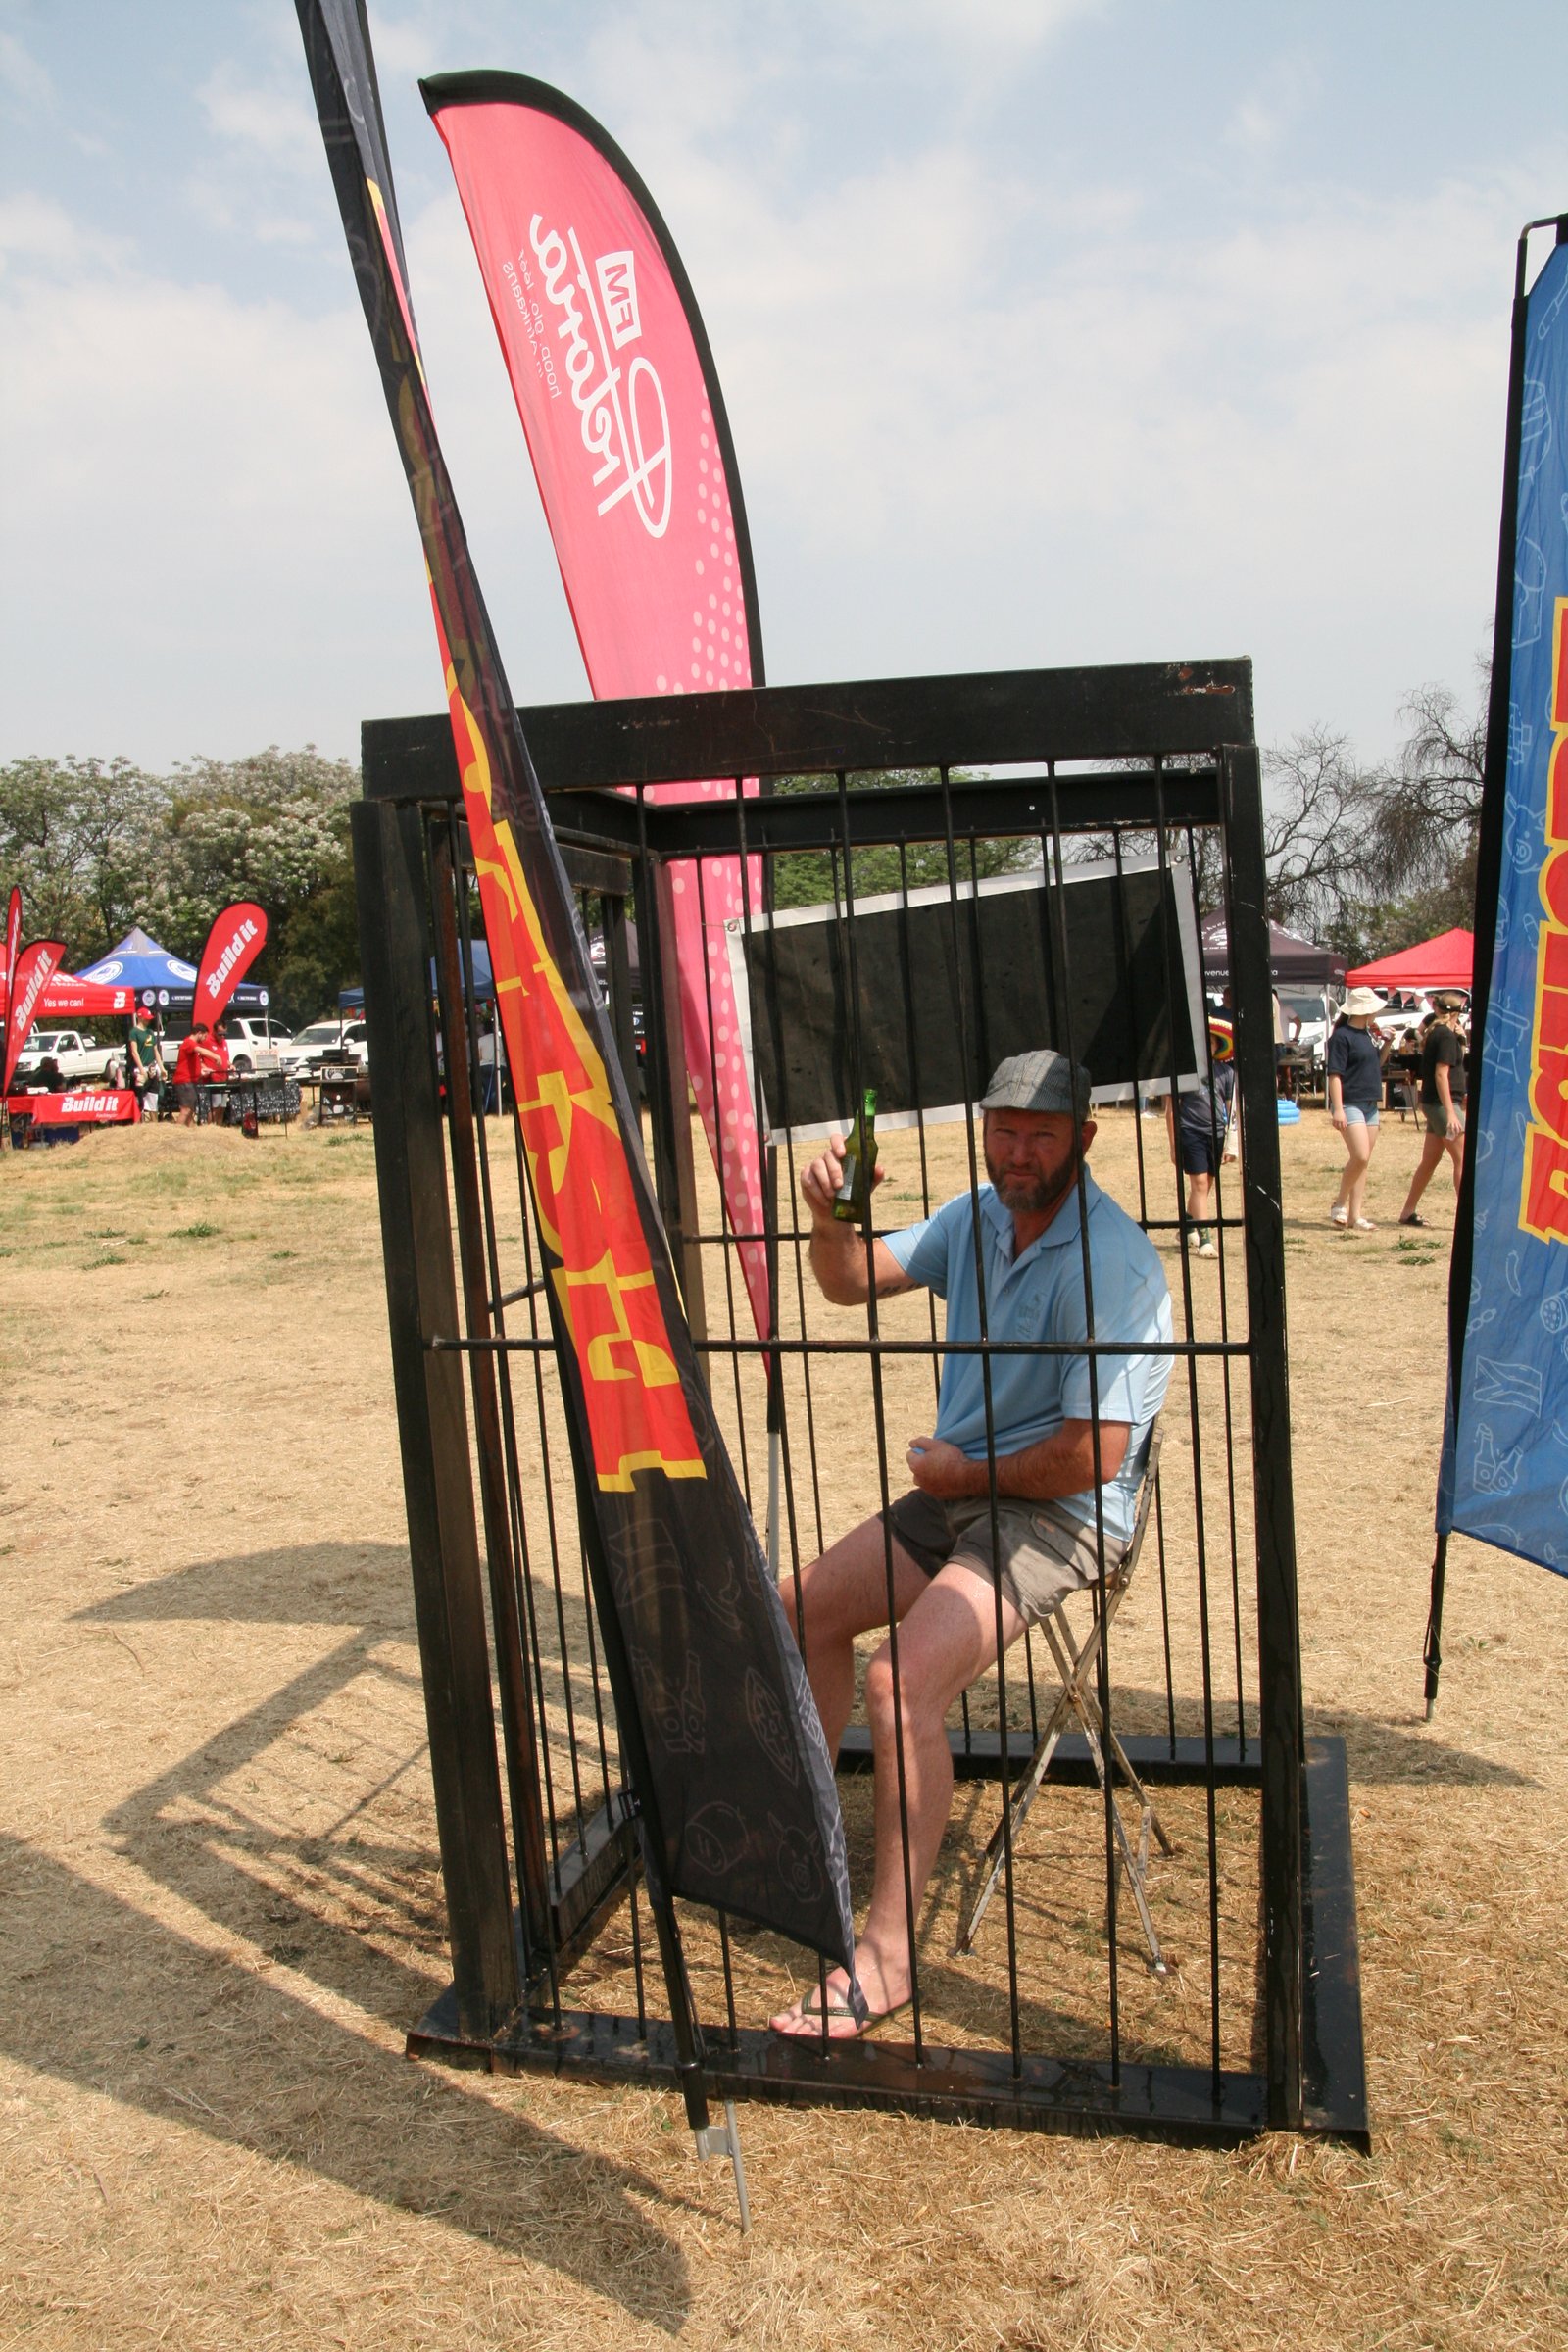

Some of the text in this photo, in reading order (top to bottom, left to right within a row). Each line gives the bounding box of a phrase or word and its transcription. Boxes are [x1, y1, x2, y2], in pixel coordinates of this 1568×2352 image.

[206, 918, 259, 999] Build it
[15, 964, 44, 1032] Build
[37, 948, 53, 975] it
[43, 997, 84, 1008] Yes we can!
[61, 1096, 119, 1113] Build it
